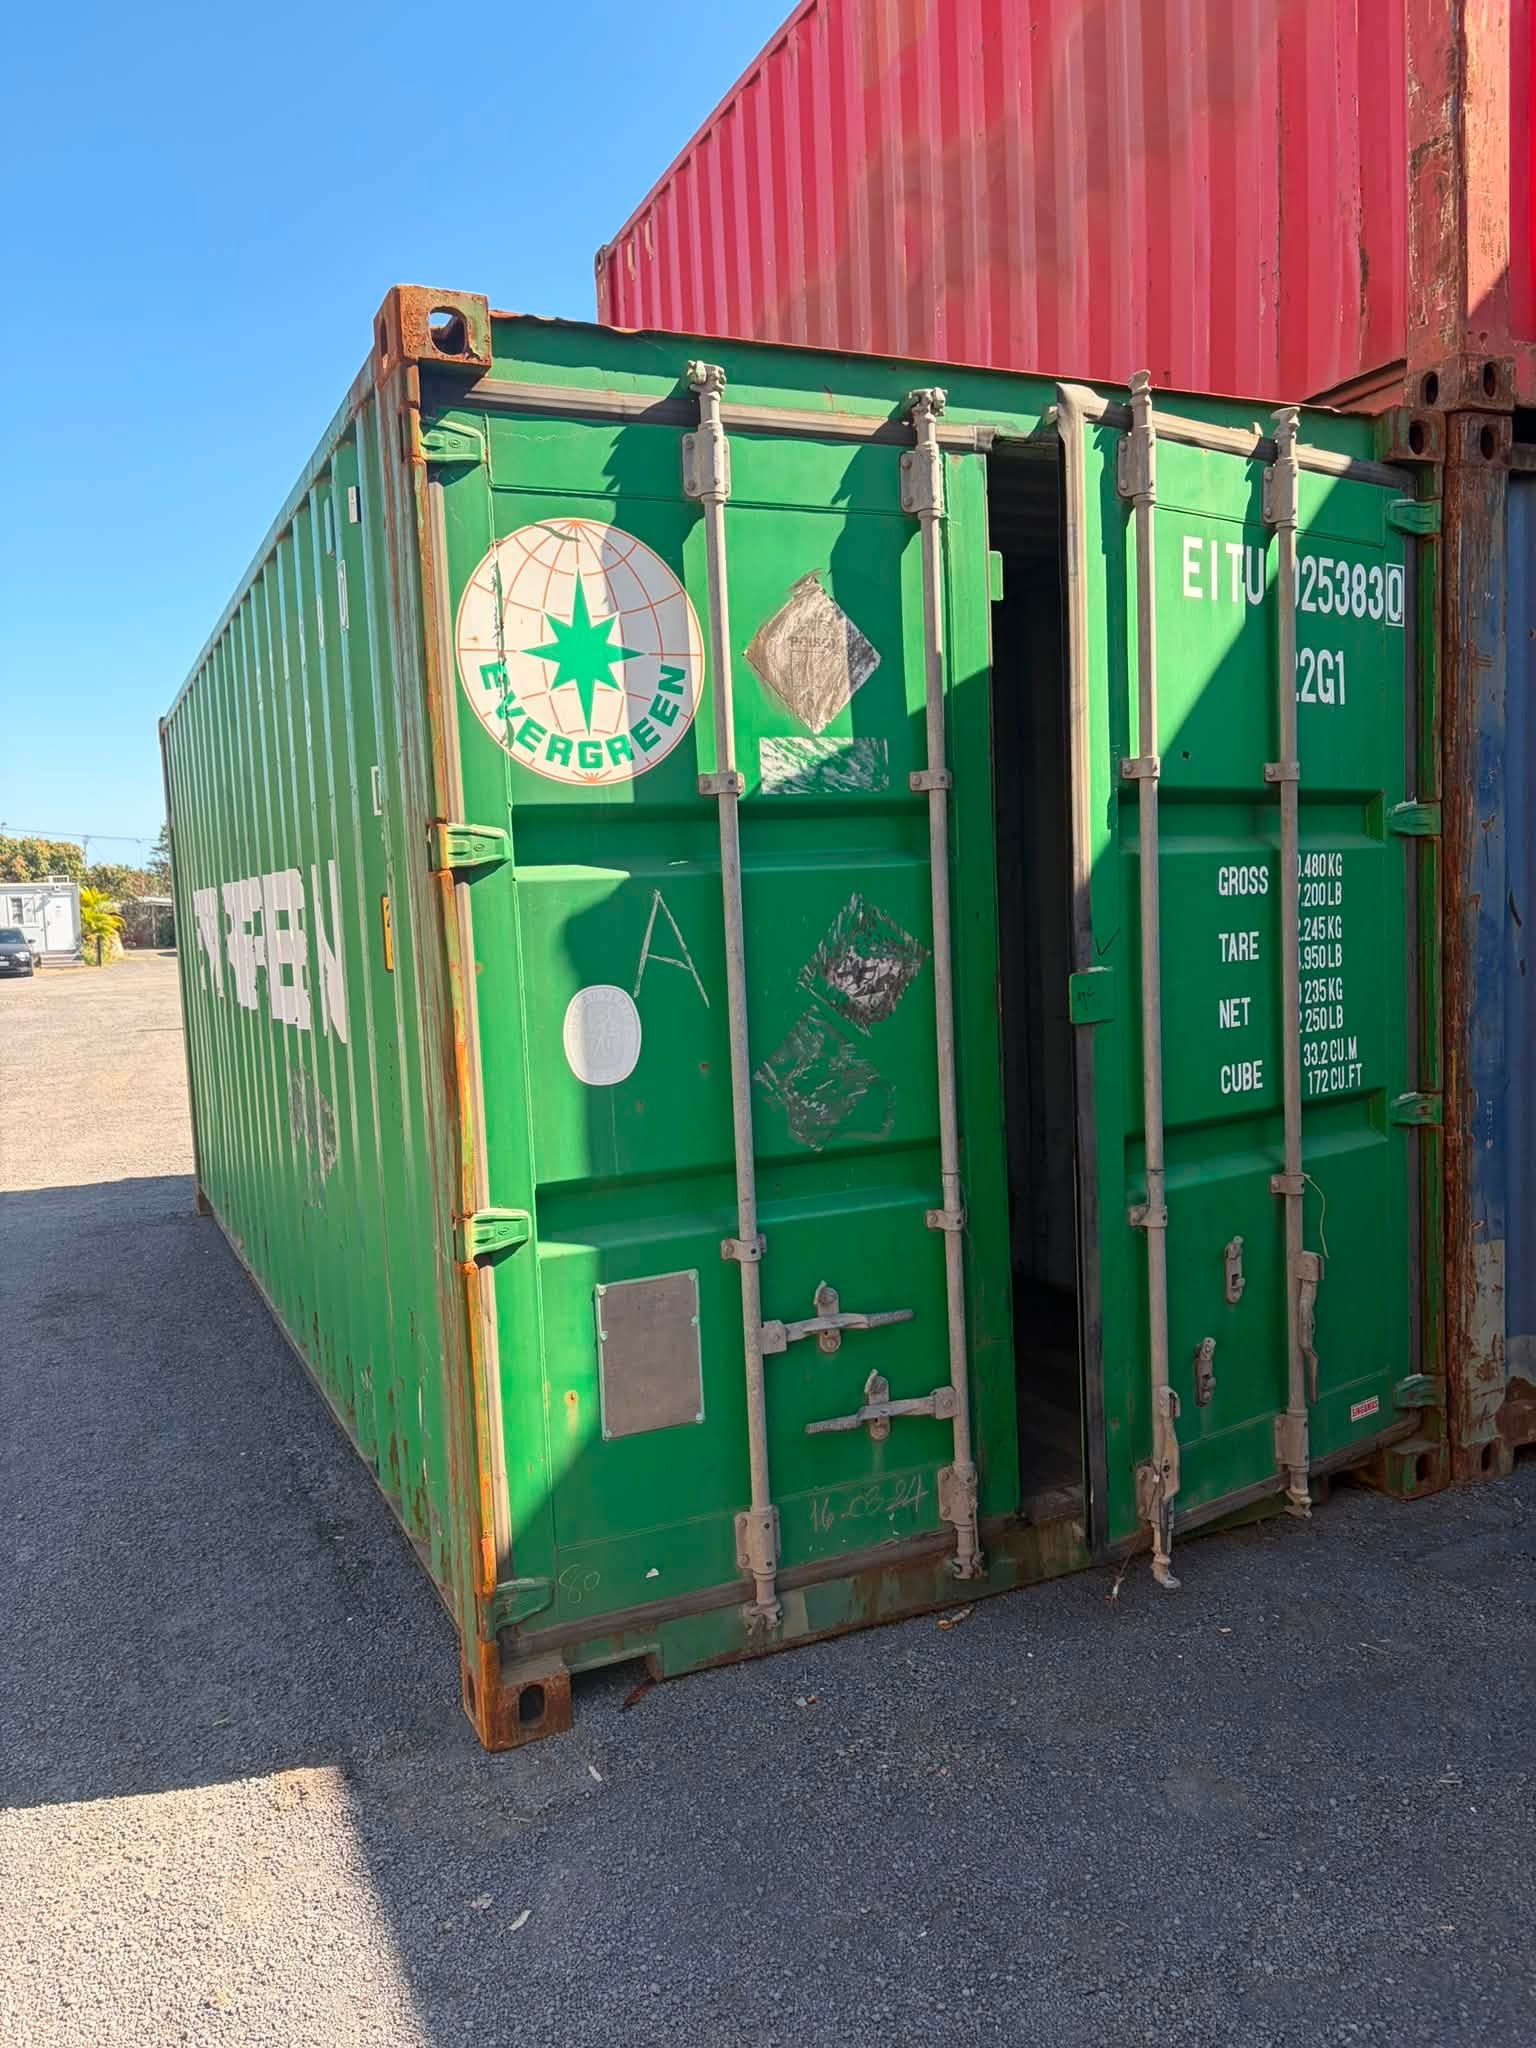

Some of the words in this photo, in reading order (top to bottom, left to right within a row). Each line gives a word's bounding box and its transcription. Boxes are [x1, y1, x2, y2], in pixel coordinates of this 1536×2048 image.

[1183, 535, 1264, 605] EITU
[1296, 648, 1346, 705] 2G1
[479, 662, 687, 769] EVERGREEN
[1328, 852, 1343, 877] KG
[1218, 866, 1269, 896] GROSS
[1328, 881, 1342, 905] LB
[1328, 915, 1342, 940] KG
[634, 888, 710, 1008] A
[1218, 932, 1260, 962] TARE
[1298, 945, 1326, 970] .950
[1328, 943, 1342, 968] LB
[1328, 977, 1343, 1001] KG
[1219, 998, 1251, 1029] NET
[1329, 1005, 1344, 1029] LB
[1220, 1060, 1264, 1094] CUBE
